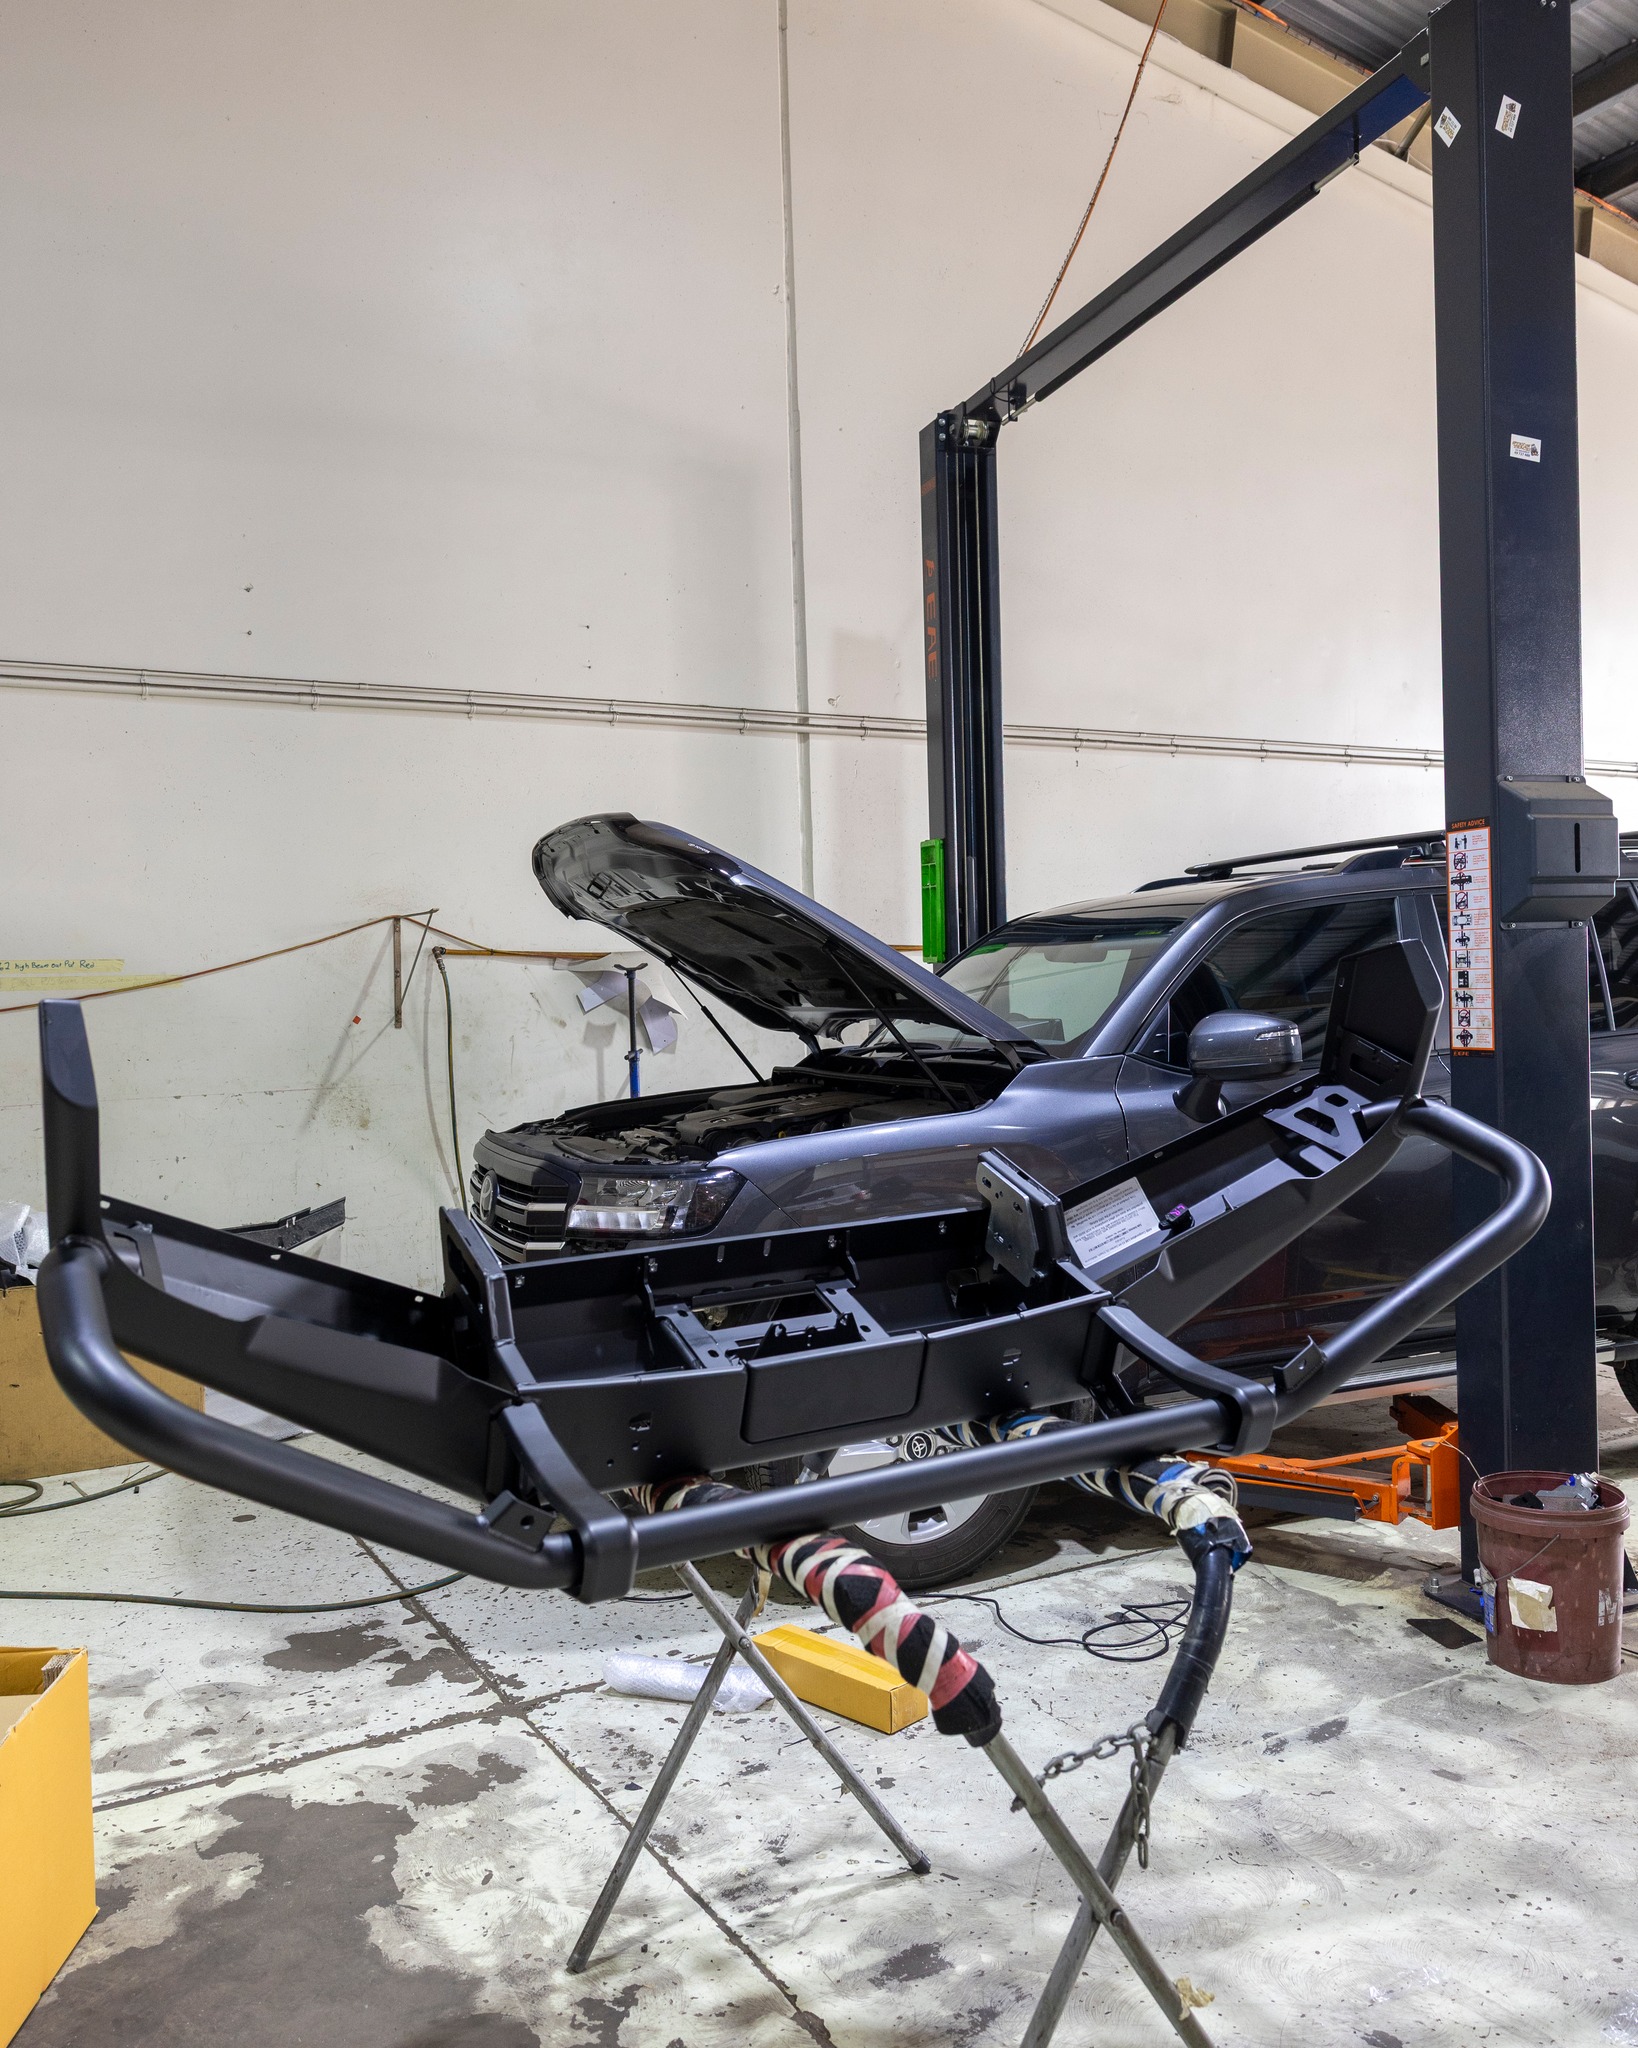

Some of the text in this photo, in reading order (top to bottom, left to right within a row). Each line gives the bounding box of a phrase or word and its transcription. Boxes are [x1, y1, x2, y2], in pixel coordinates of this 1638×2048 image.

[1451, 818, 1485, 829] SAFETY ADVICE
[79, 959, 95, 970] Red
